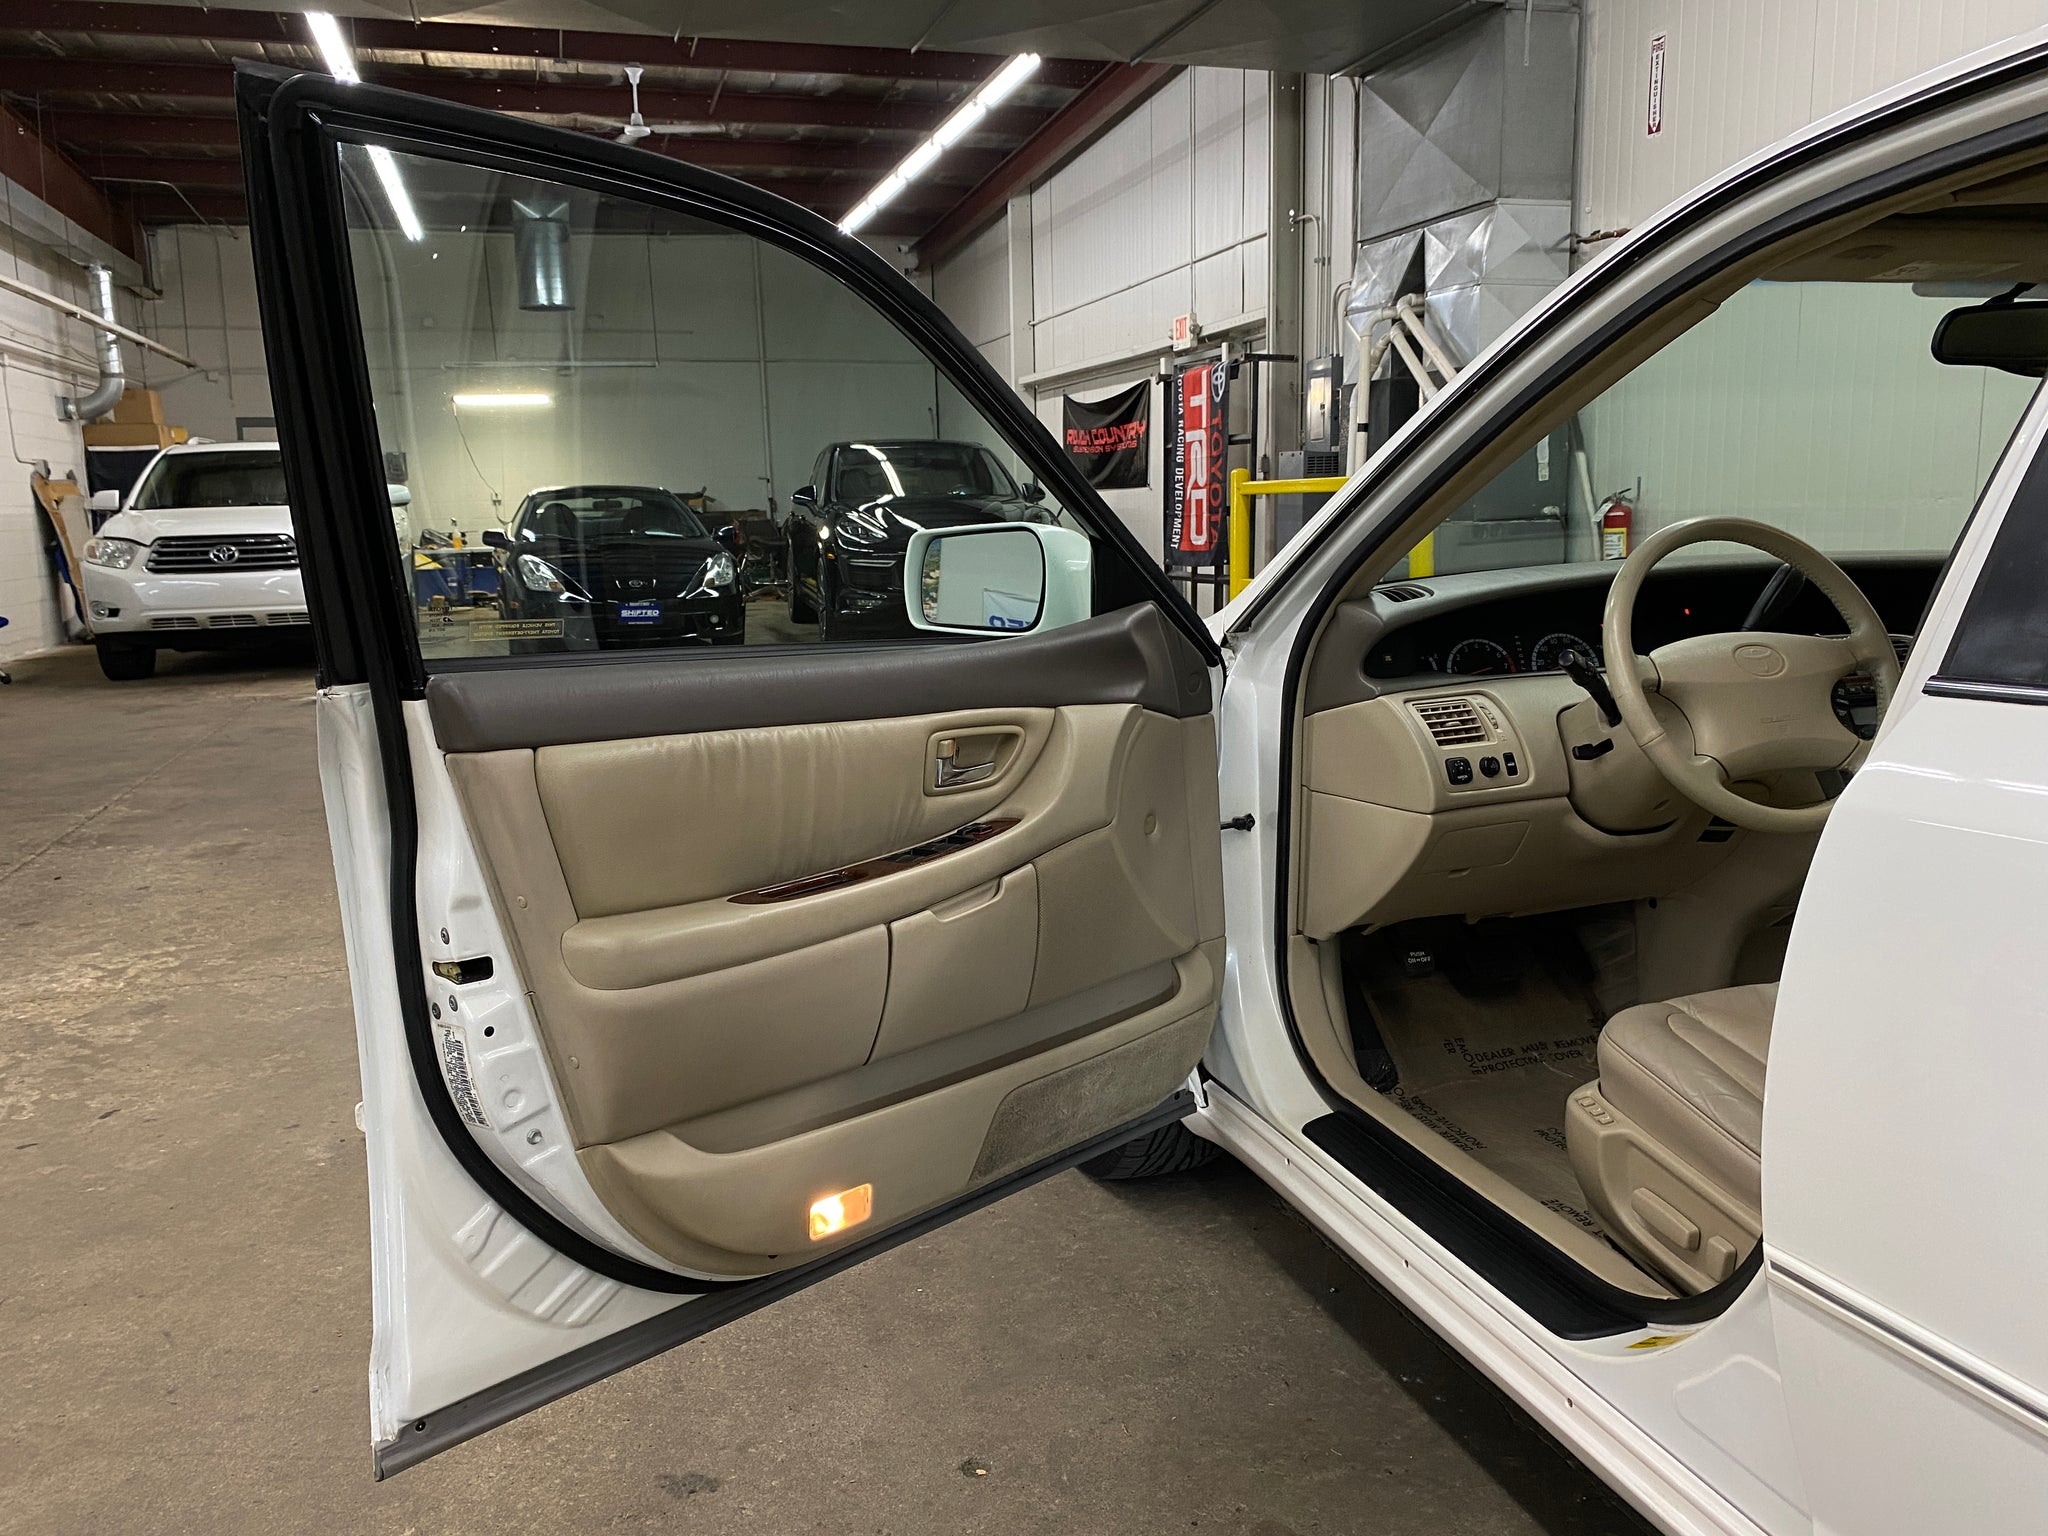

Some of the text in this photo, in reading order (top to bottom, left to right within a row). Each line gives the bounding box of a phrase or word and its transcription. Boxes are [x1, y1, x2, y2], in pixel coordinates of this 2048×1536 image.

[1175, 316, 1188, 340] EXIT
[1186, 369, 1208, 546] TRD
[1210, 408, 1224, 551] TOYOTA
[1170, 467, 1184, 550] DEVELOPMENT
[620, 609, 660, 618] SHIFTED
[1475, 1047, 1517, 1063] DEALER
[1553, 1034, 1598, 1049] REMOVE
[1480, 1052, 1546, 1075] PROTECTIVE
[1439, 1130, 1474, 1152] DEALER
[1543, 1198, 1595, 1228] REMOVE
